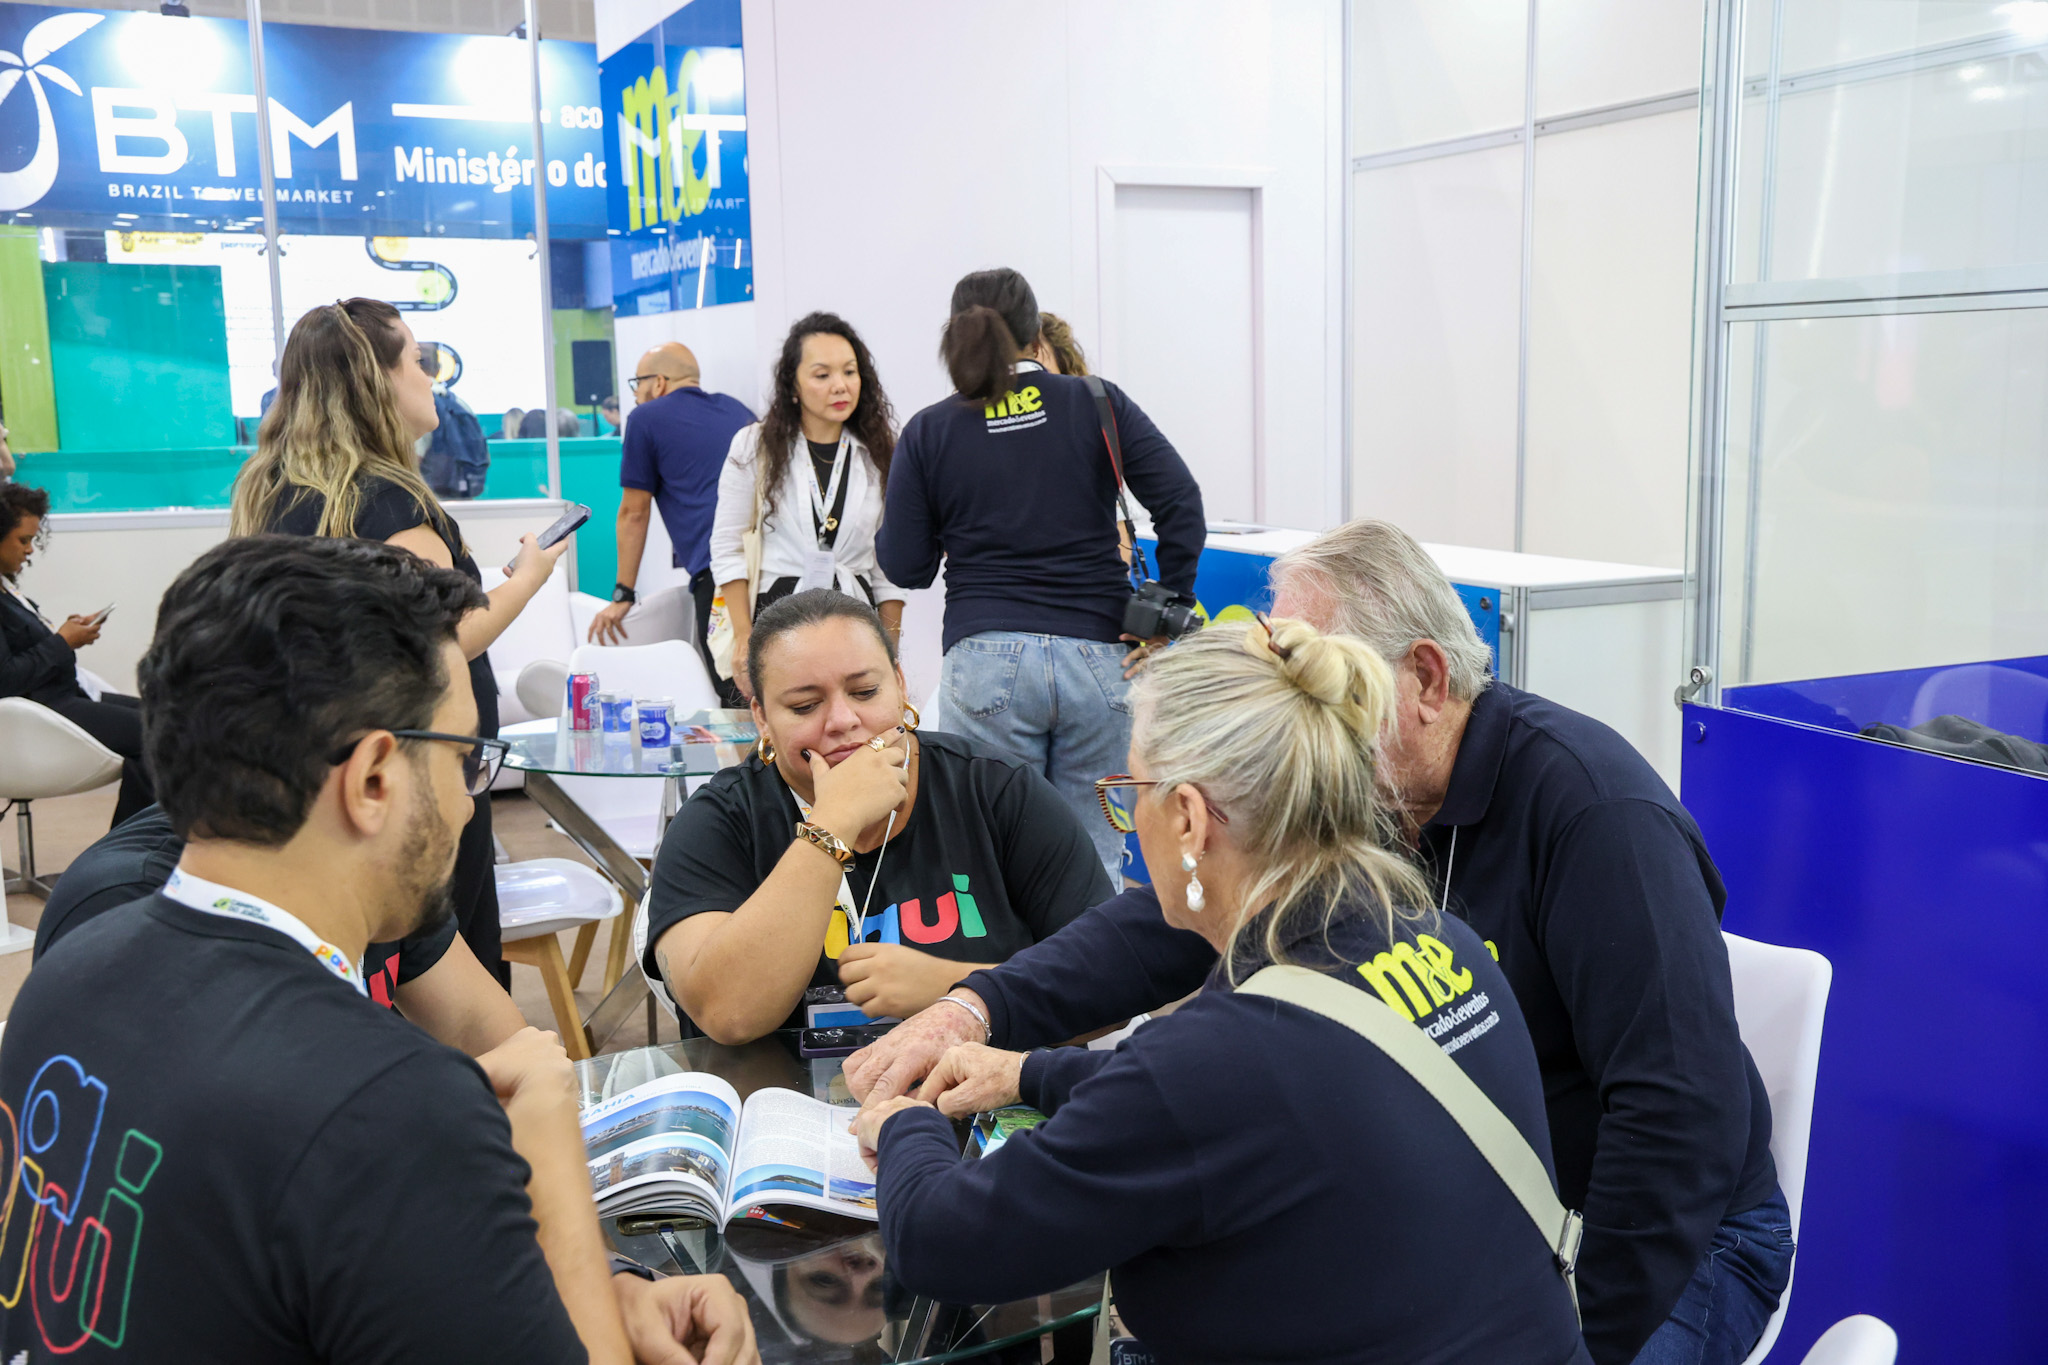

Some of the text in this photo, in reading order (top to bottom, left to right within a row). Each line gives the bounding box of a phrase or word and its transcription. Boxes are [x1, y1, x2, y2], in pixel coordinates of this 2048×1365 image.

[91, 86, 358, 181] BTM
[394, 145, 568, 188] Ministéro
[108, 183, 184, 200] BRAZIL
[276, 189, 354, 204] MARKET
[1423, 991, 1490, 1038] rcado&eventos
